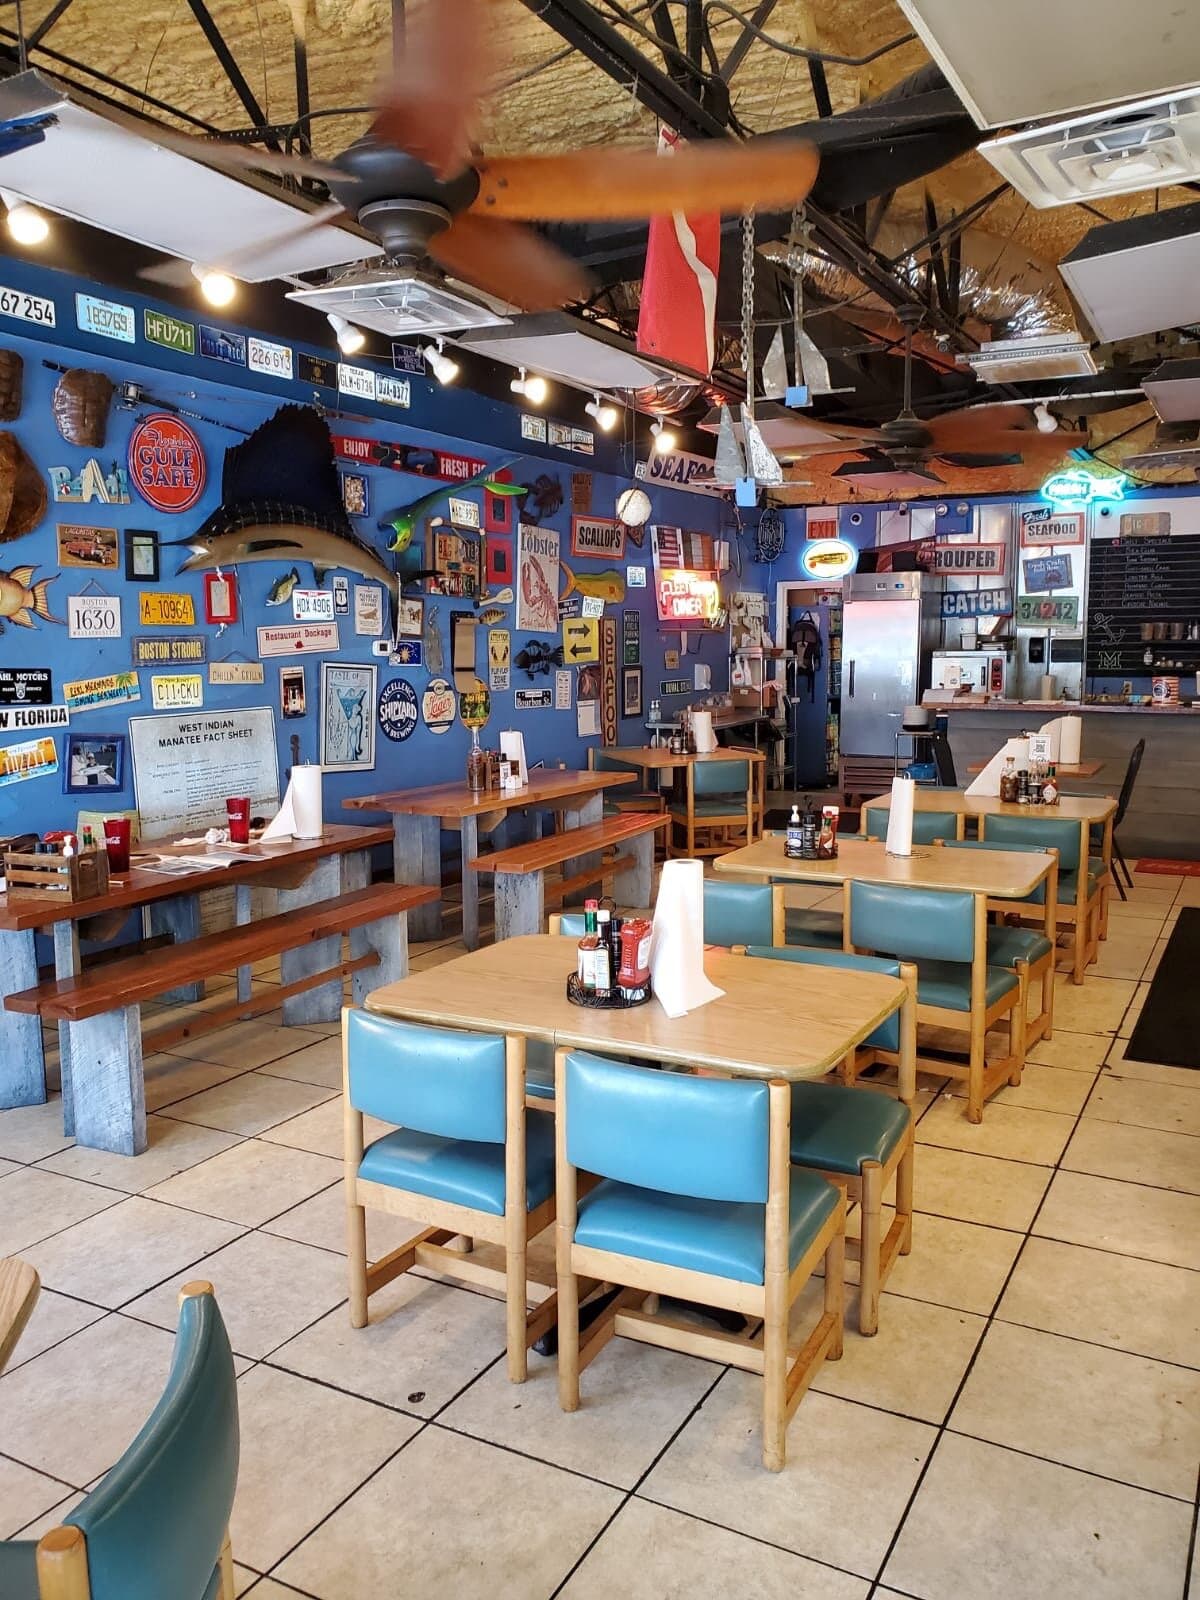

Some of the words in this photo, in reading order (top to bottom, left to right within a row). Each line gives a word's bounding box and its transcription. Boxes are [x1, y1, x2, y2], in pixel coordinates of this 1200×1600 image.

[24, 298, 54, 324] 254
[86, 305, 128, 332] 183769
[147, 317, 191, 347] HFU711
[251, 346, 271, 366] 226
[273, 351, 291, 370] GY3
[139, 446, 194, 467] GULF
[343, 438, 370, 457] ENJOY
[141, 466, 196, 488] SAFE
[440, 456, 468, 479] FRESH
[578, 526, 621, 548] SCALLOPS
[809, 521, 836, 539] EXIT
[1028, 523, 1076, 537] SEAFOOD
[520, 532, 558, 558] Lobster
[144, 599, 189, 619] A-10964
[312, 598, 331, 613] 4906
[942, 590, 1006, 615] CATCH
[1021, 602, 1073, 620] 34242
[75, 609, 116, 630] 1630
[264, 630, 302, 641] Restaurant
[304, 628, 332, 639] Dockage
[138, 642, 170, 660] BOSTON
[171, 641, 202, 659] STRONG
[16, 672, 49, 681] MOTORS
[74, 694, 95, 707] SMOKE
[381, 681, 416, 703] EXCELLENCE
[379, 701, 417, 722] SHIPYARD
[516, 697, 542, 707] Bourbon
[15, 708, 67, 727] FLORIDA
[178, 722, 202, 733] WEST
[205, 719, 234, 731] INDIAN
[158, 735, 202, 748] MANATEE
[203, 732, 226, 743] FACT
[228, 729, 254, 740] SHEET
[383, 722, 390, 733] IN
[389, 720, 415, 739] BREWING
